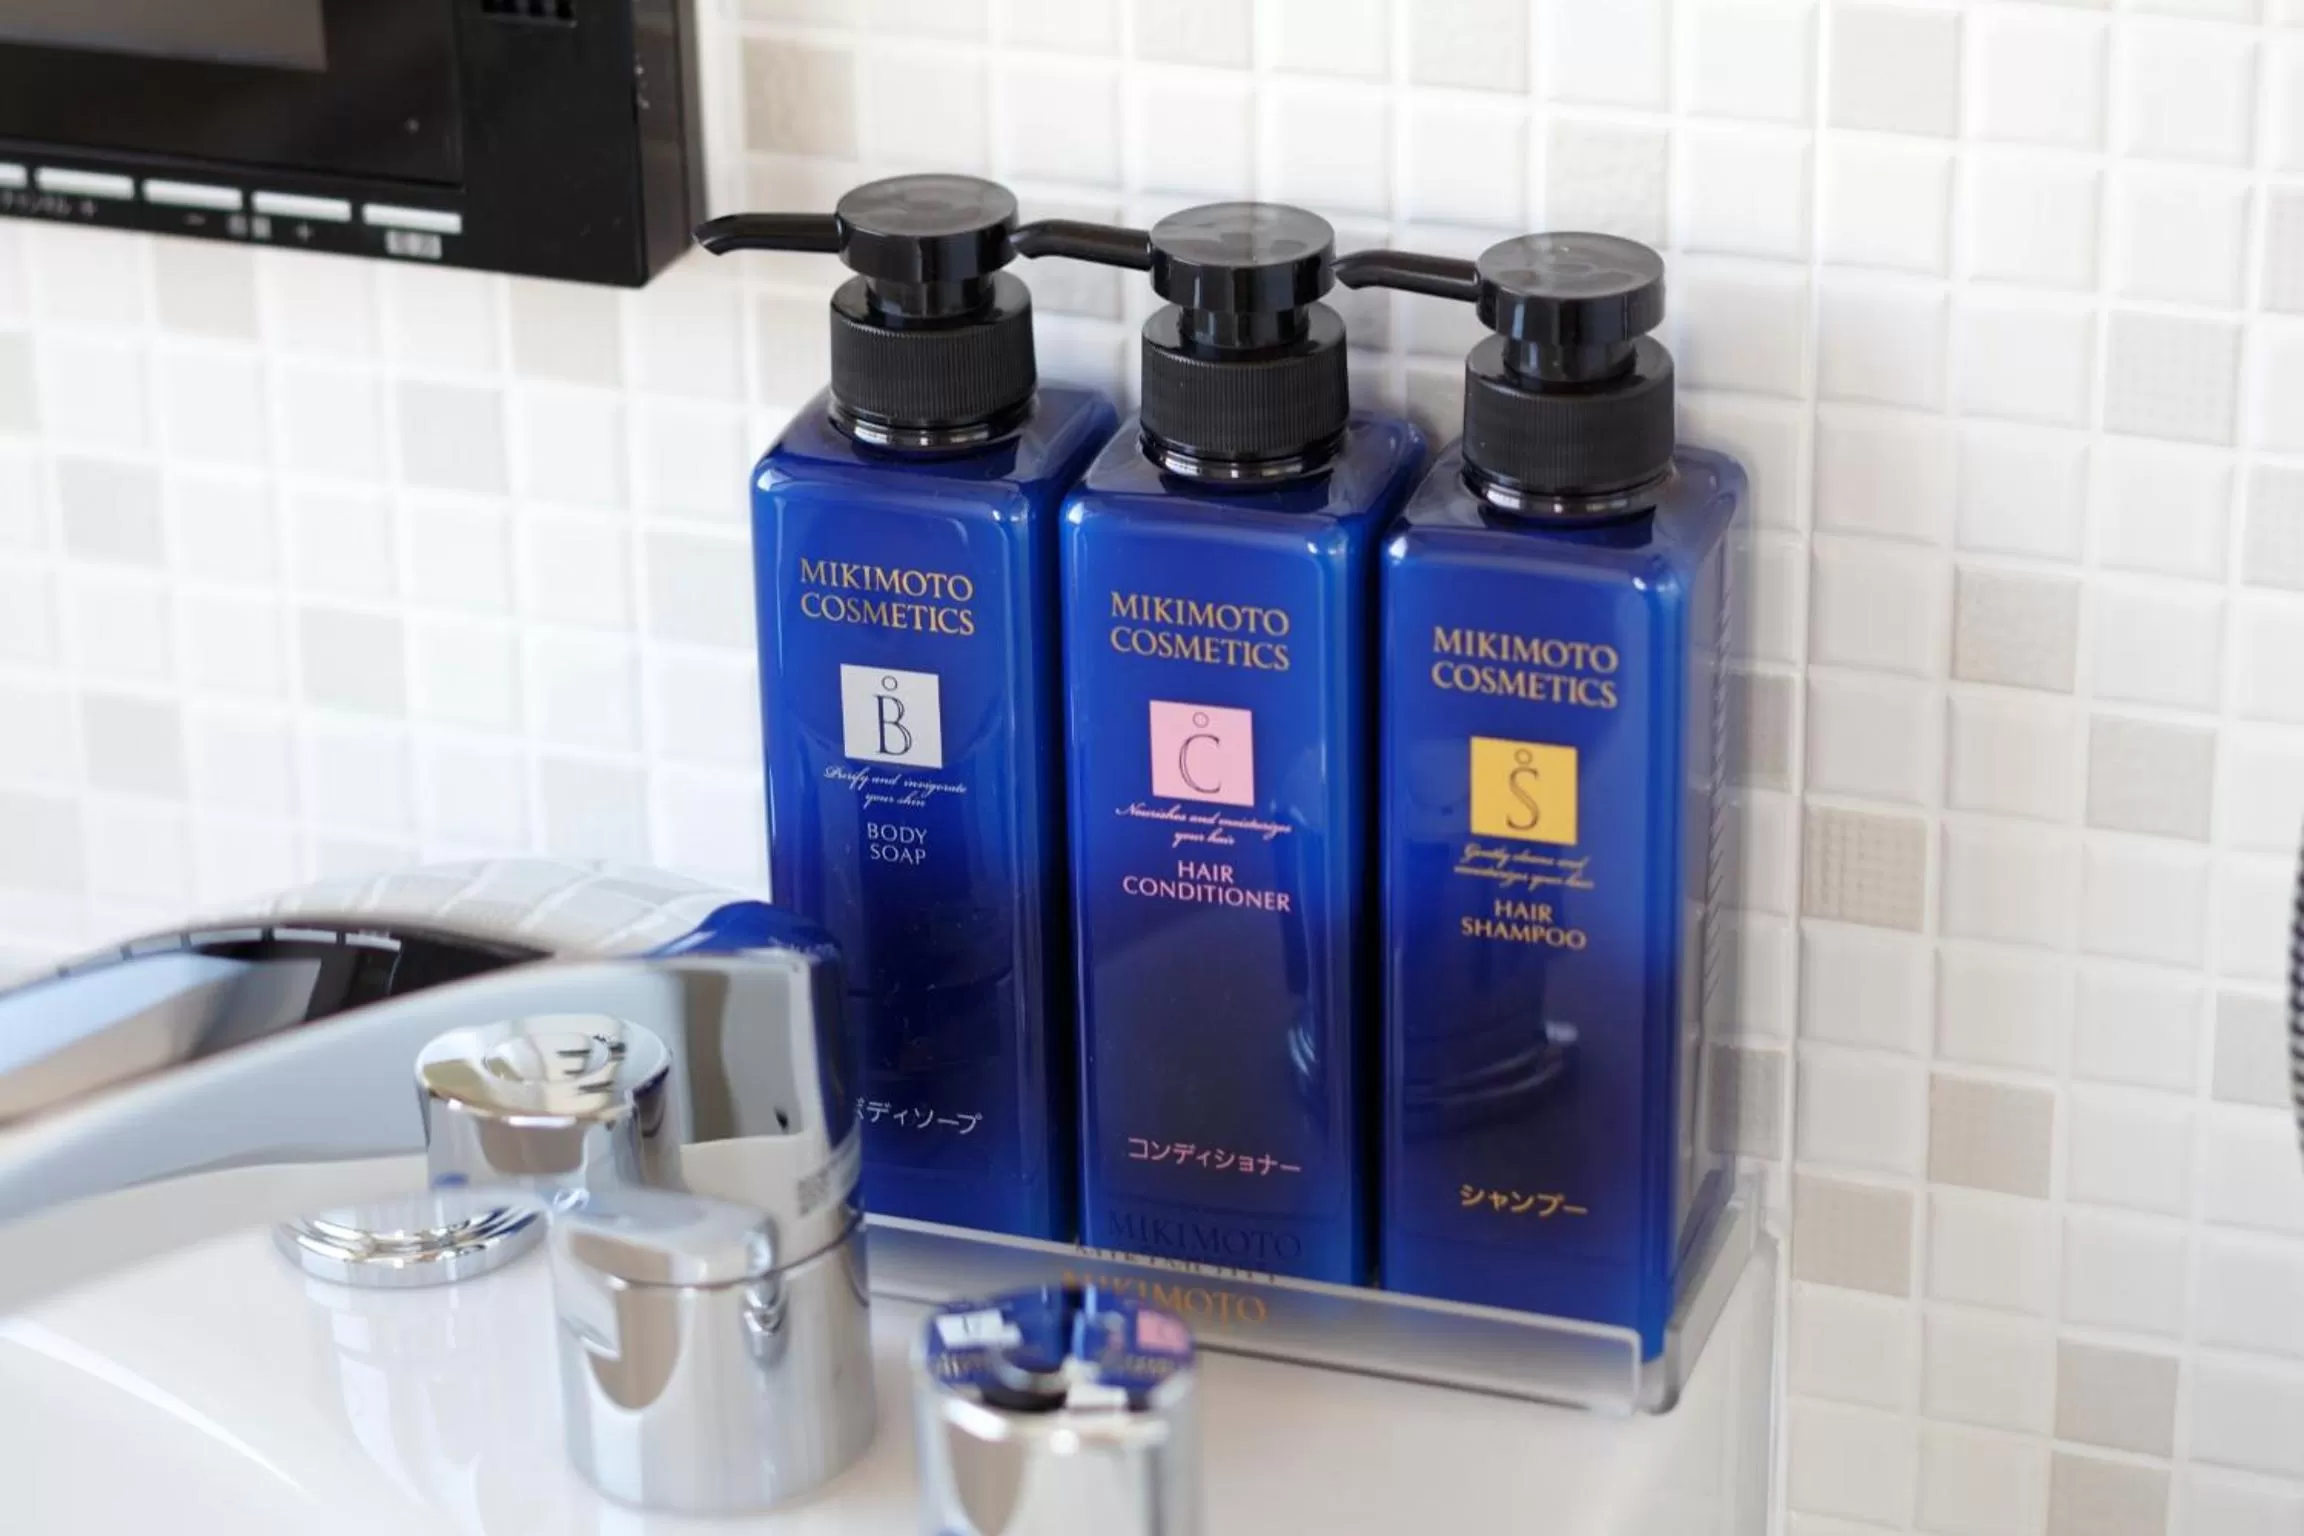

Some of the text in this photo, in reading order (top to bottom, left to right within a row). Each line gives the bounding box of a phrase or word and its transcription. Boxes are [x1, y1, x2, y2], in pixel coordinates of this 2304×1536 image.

[801, 558, 975, 602] MIKIMOTO
[801, 592, 976, 636] COSMETICS
[1110, 591, 1290, 637] MIKIMOTO
[1110, 626, 1291, 672] COSMETICS
[1433, 626, 1619, 673] MIKIMOTO
[1431, 661, 1619, 709] COSMETICS
[871, 774, 902, 786] and
[867, 821, 928, 845] BODY
[1189, 811, 1222, 826] and
[870, 843, 927, 866] SOAP
[1177, 859, 1235, 884] HAIR
[1122, 875, 1292, 913] CONDITIONER
[1494, 898, 1554, 924] HAIR
[1461, 915, 1588, 950] SHAMPOO
[1128, 1136, 1302, 1177] コンディショナー
[1459, 1183, 1589, 1218] シャンプー
